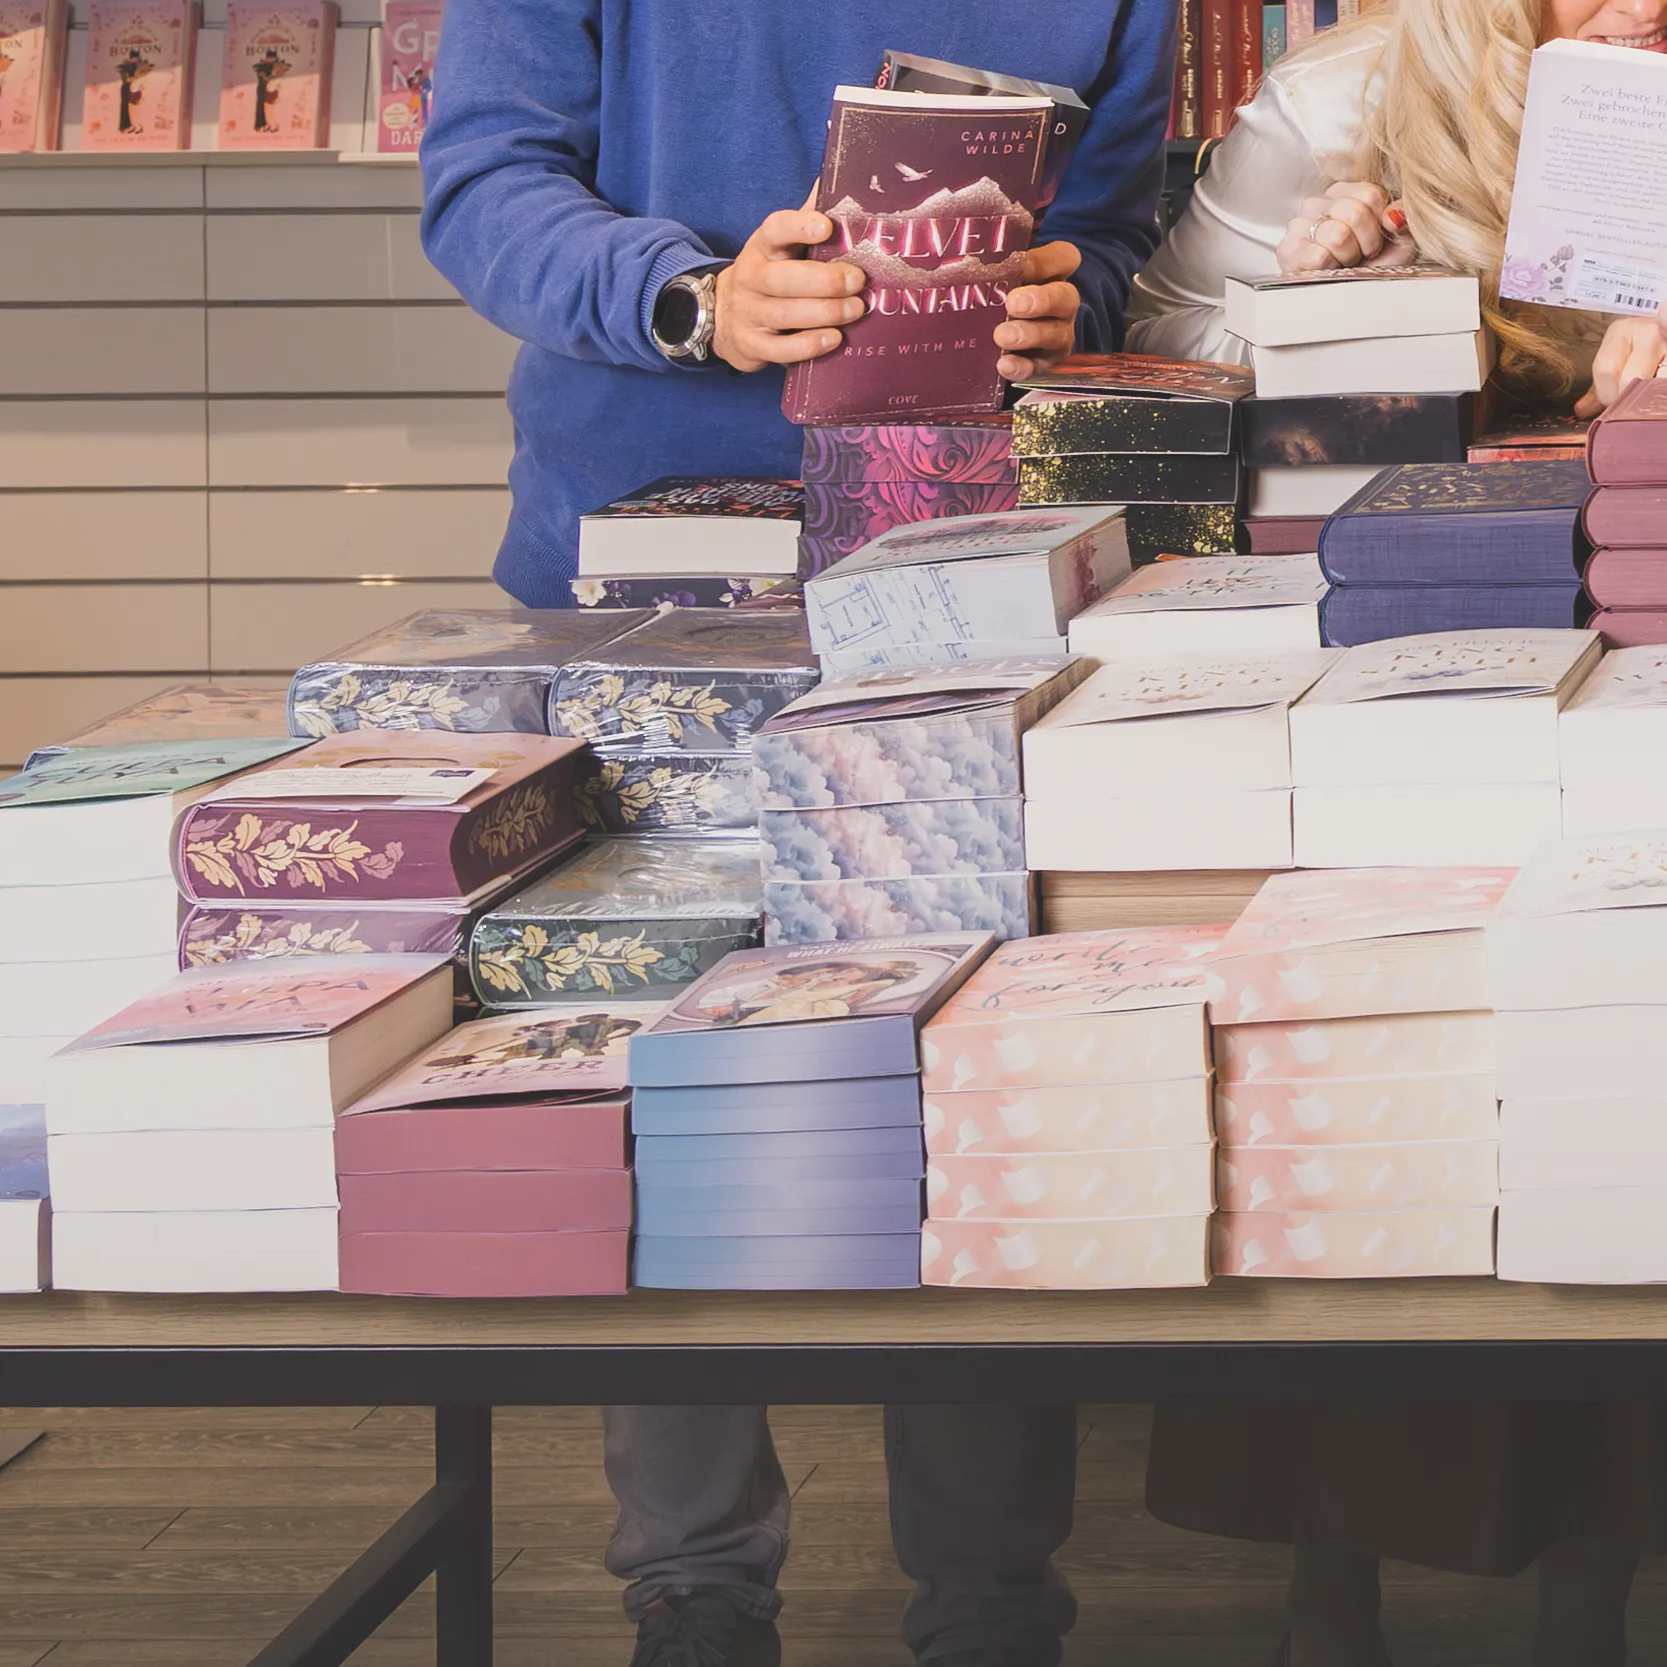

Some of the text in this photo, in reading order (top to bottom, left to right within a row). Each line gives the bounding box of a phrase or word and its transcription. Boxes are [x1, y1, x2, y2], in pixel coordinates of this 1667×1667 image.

[1561, 92, 1591, 109] Zwei
[1580, 83, 1611, 101] Zwei
[1615, 87, 1652, 105] beste
[1578, 110, 1608, 124] Eine
[1611, 114, 1654, 132] zweite
[961, 130, 1034, 142] CARINA
[966, 143, 1026, 155] WILDE
[839, 215, 1011, 258] VELVET
[864, 282, 1011, 316] OUNTAINS
[844, 337, 977, 357] RISE WITH ME
[888, 395, 918, 405] COVE
